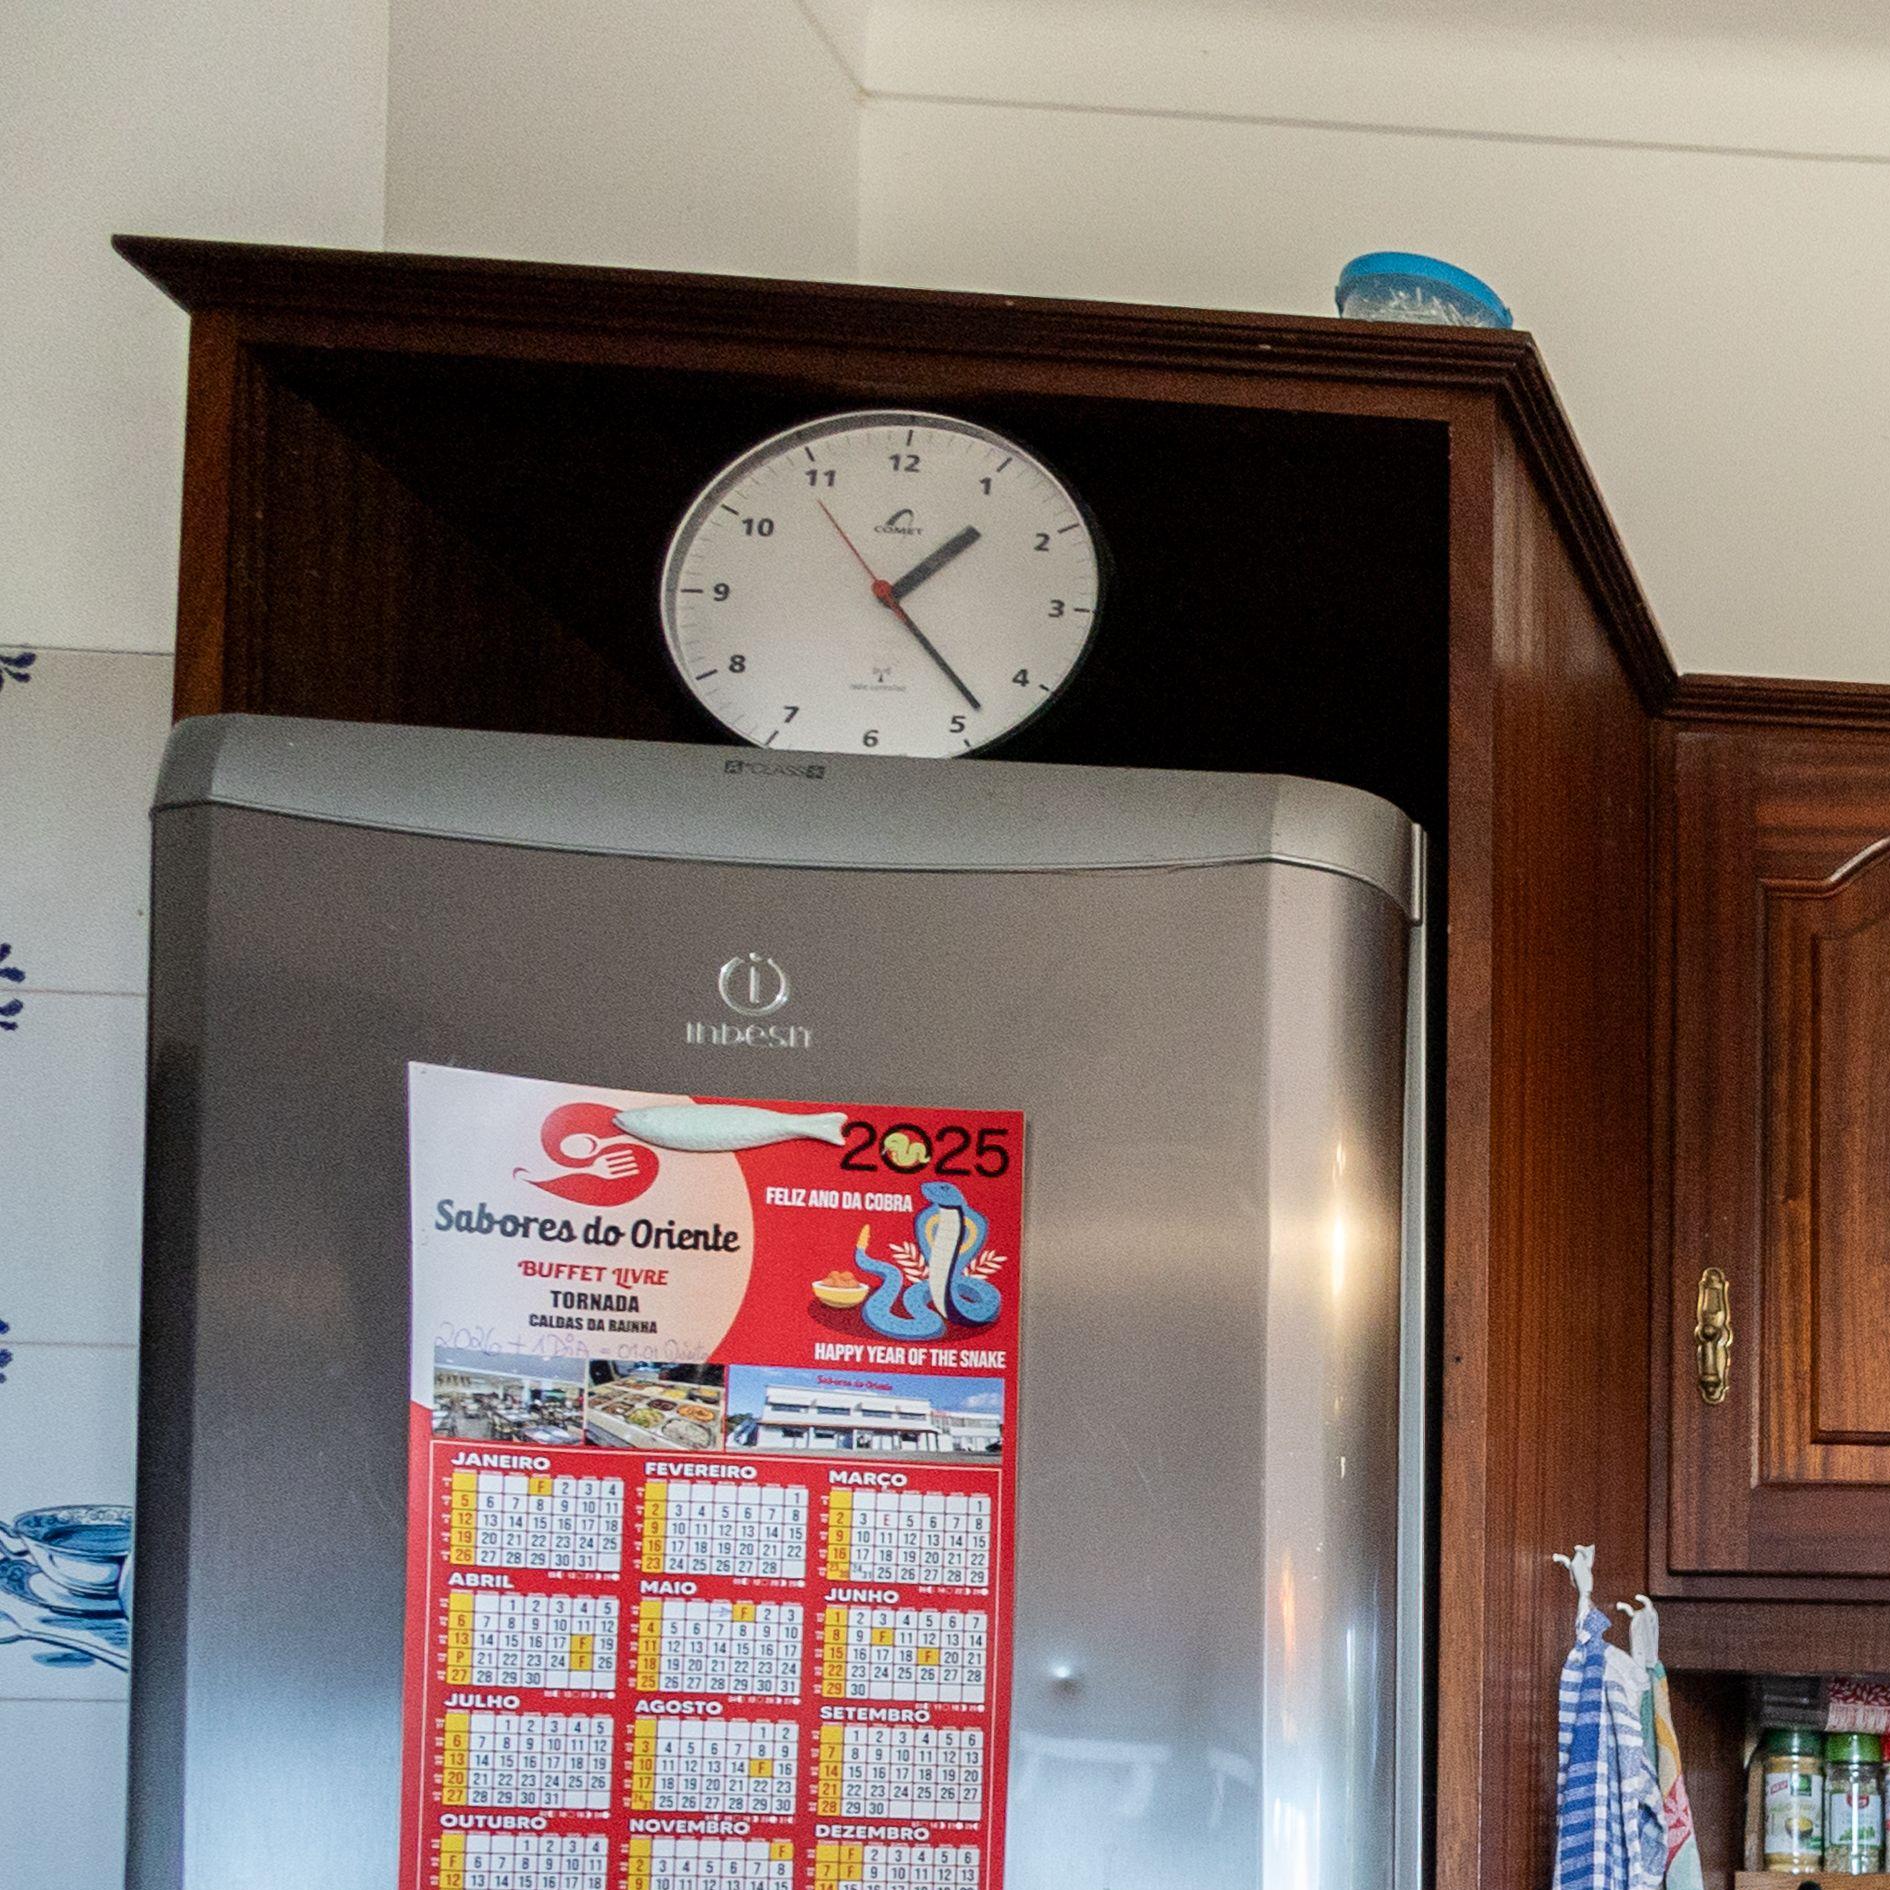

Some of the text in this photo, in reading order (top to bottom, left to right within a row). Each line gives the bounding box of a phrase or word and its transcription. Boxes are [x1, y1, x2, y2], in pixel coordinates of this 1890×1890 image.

[889, 455, 920, 473] 12
[805, 470, 835, 487] 11
[980, 478, 992, 495] 1
[742, 518, 774, 537] 10
[1033, 534, 1050, 551] 2
[713, 583, 730, 601] 9
[1048, 600, 1065, 617] 3
[728, 655, 746, 673] 8
[1012, 669, 1029, 687] 4
[783, 706, 799, 723] 7
[949, 715, 965, 733] 5
[863, 730, 879, 748] 6
[841, 1121, 1009, 1177] 2025
[766, 1186, 913, 1212] FELIZ ANO DA COBRA
[435, 1199, 740, 1252] Sabores do Oriente
[517, 1260, 669, 1289] BUFFET LIVRE
[550, 1290, 640, 1313] TORNADA
[529, 1314, 658, 1334] CALDAS DA RAINHA
[814, 1342, 1006, 1369] HAPPY YEAR OF THE SNAKE
[450, 1452, 551, 1471] JANEIRO
[644, 1462, 757, 1481] FEVEREIRO
[828, 1470, 908, 1492] MARÇO
[448, 1572, 514, 1589] ABRIL
[640, 1580, 698, 1596] MAIO
[824, 1588, 900, 1605] JUNHO
[444, 1693, 520, 1711] JULHO
[634, 1700, 723, 1717] AGOSTO
[820, 1706, 931, 1724] SETEMBRO
[527, 1719, 535, 1732] 2
[550, 1720, 558, 1733] 3
[574, 1721, 581, 1733] 4
[597, 1721, 604, 1735] 5
[453, 1735, 607, 1752] 6 7 8 9 10 11 12
[450, 1752, 606, 1770] 13 14 15 16 17 18 19
[448, 1771, 606, 1789] 20 21 22 23 24 25 26
[447, 1789, 559, 1805] 27 28 29 30 31
[439, 1813, 548, 1832] OUTUBRO
[629, 1818, 751, 1836] NOVEMBRO
[815, 1823, 930, 1842] DEZEMBRO
[871, 1849, 879, 1861] 2
[895, 1849, 902, 1862] 3
[917, 1851, 925, 1862] 4
[941, 1851, 948, 1864] 5
[964, 1851, 972, 1864] 6
